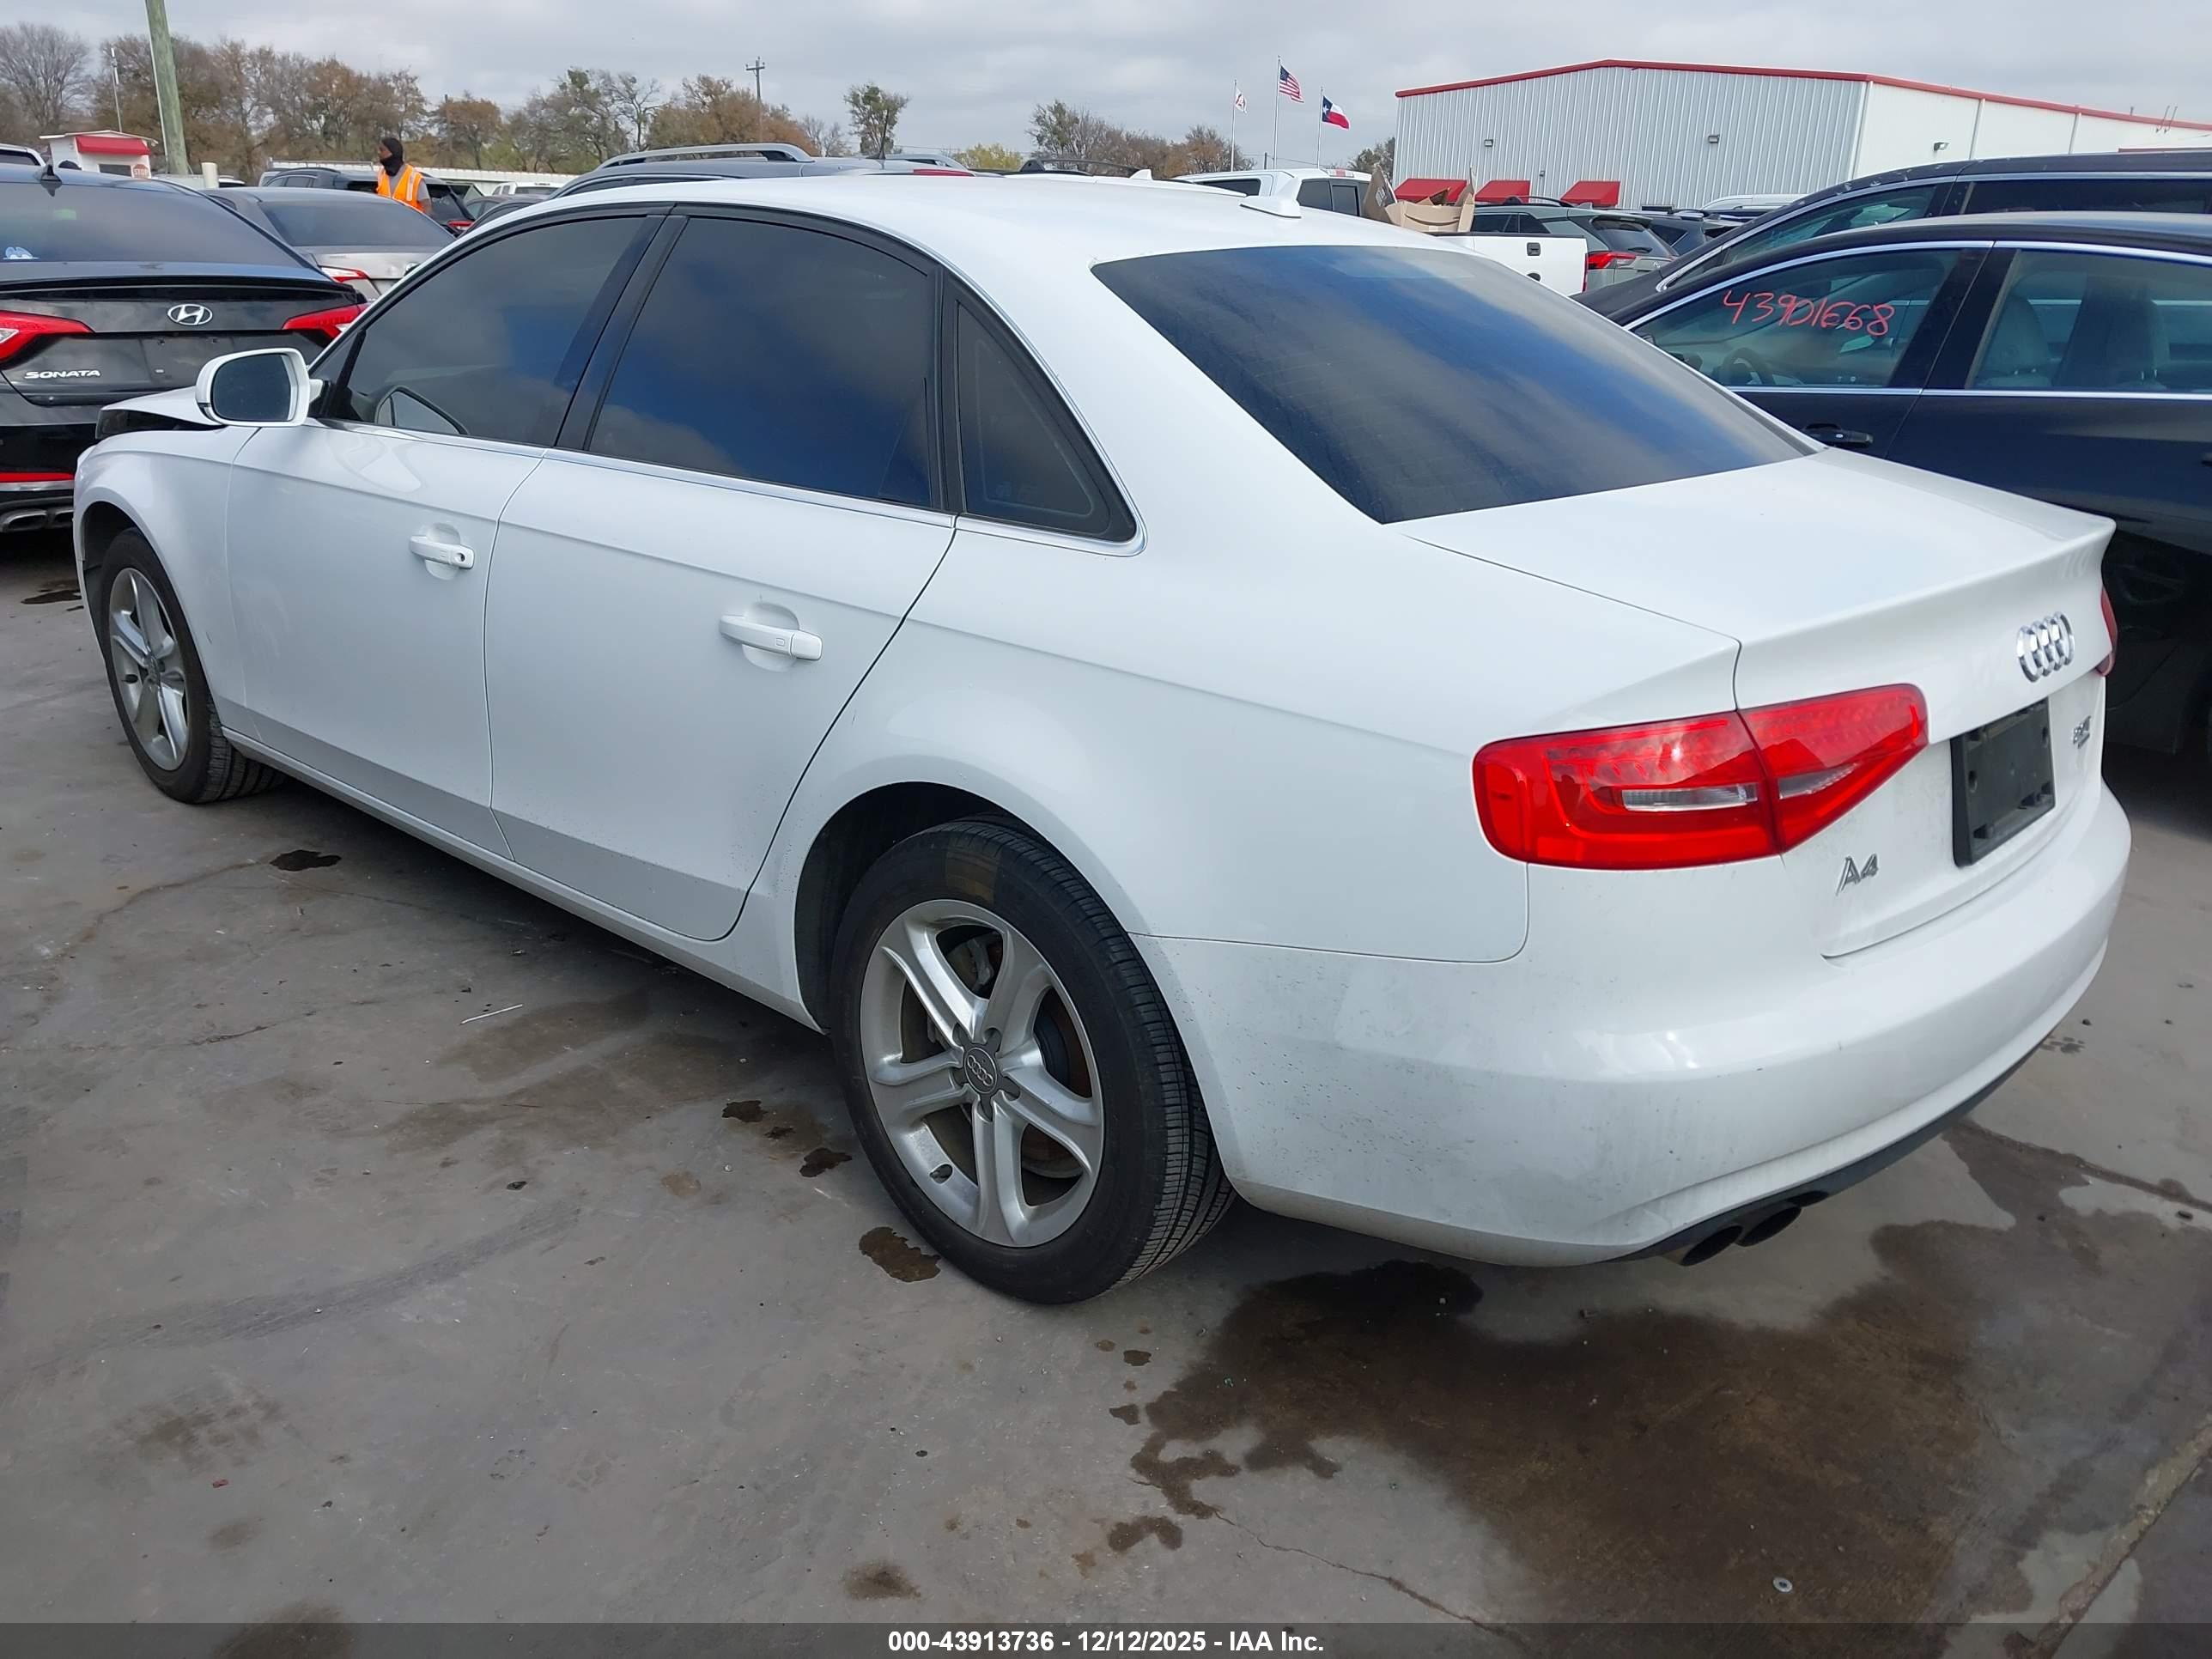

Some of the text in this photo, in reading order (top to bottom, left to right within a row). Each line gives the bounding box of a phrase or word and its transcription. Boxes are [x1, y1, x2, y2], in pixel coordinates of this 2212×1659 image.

[1723, 289, 1895, 336] 43901668
[24, 370, 101, 379] SONATA
[1835, 854, 1879, 896] A4
